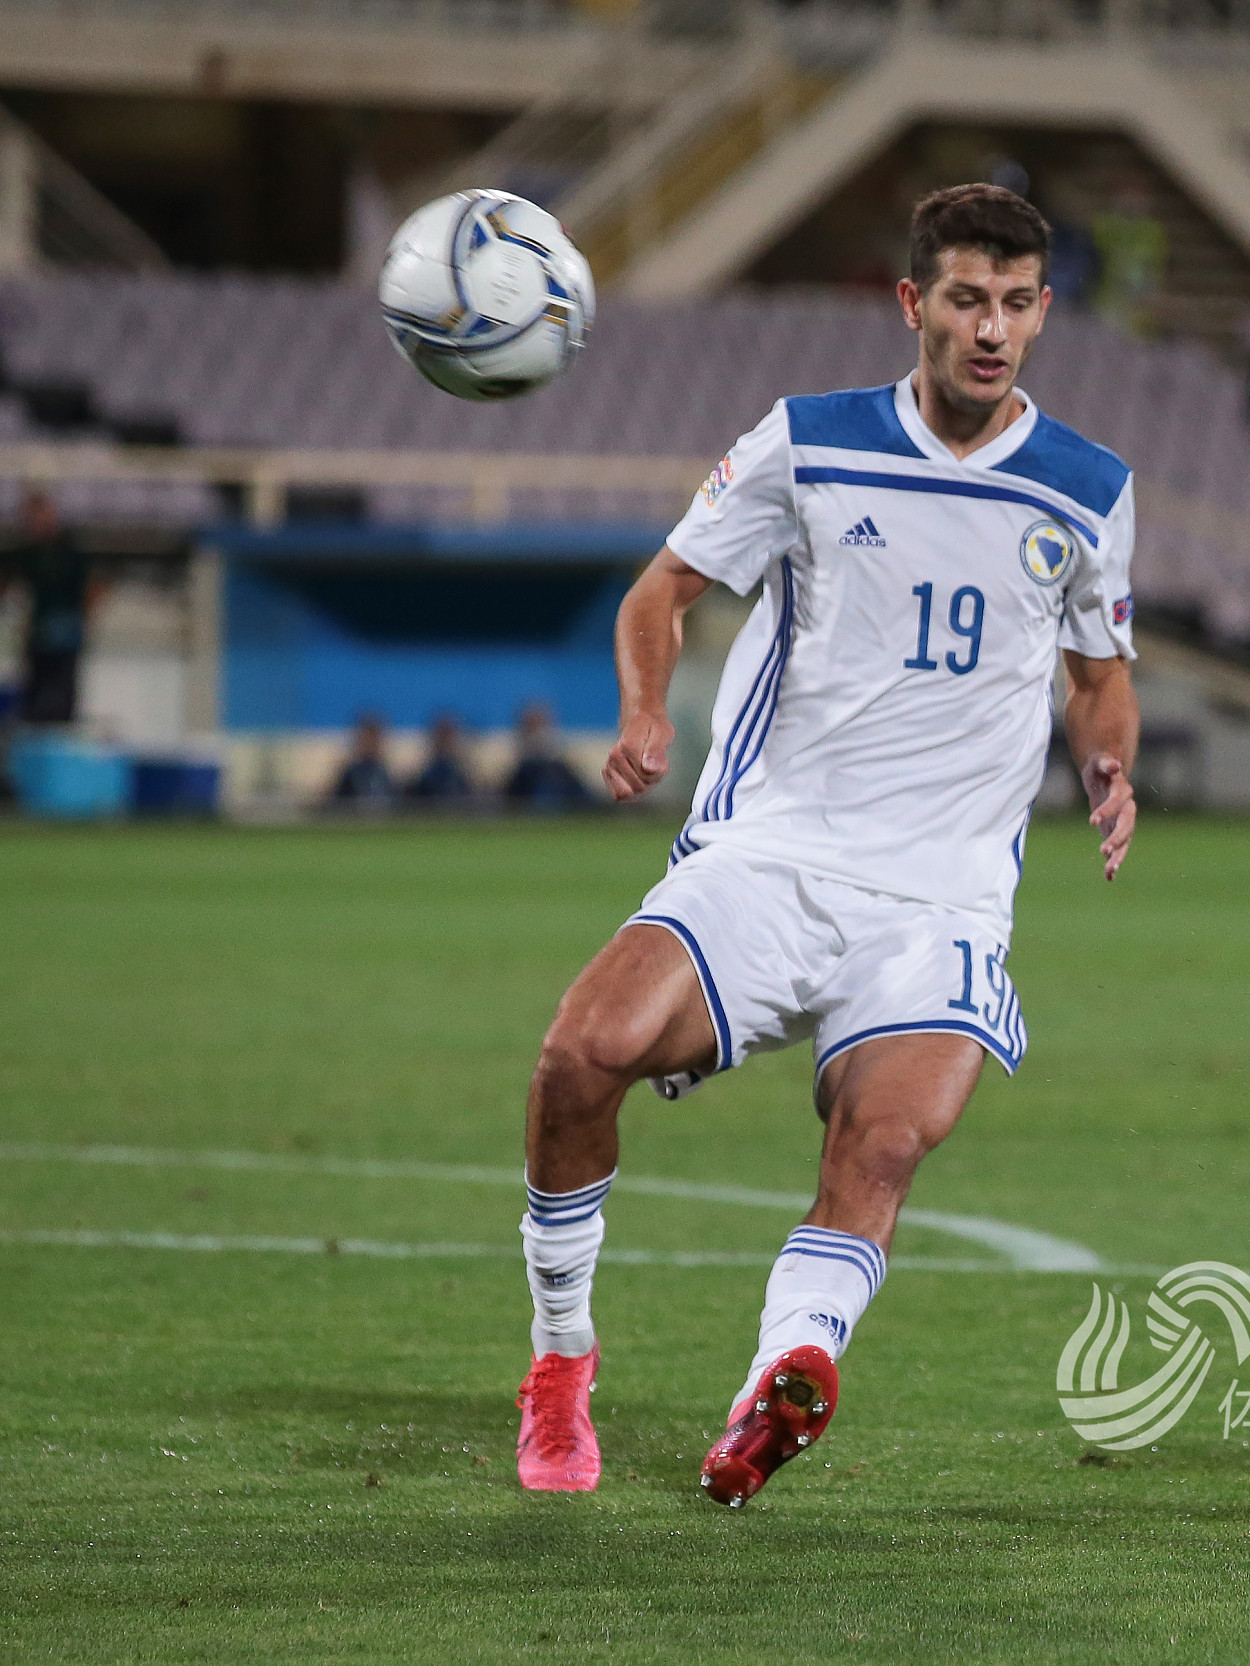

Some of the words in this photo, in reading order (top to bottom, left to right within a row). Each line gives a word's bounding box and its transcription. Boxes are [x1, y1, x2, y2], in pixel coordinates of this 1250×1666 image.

[838, 535, 887, 547] adidas
[904, 582, 985, 675] 19
[947, 940, 1006, 1030] 19
